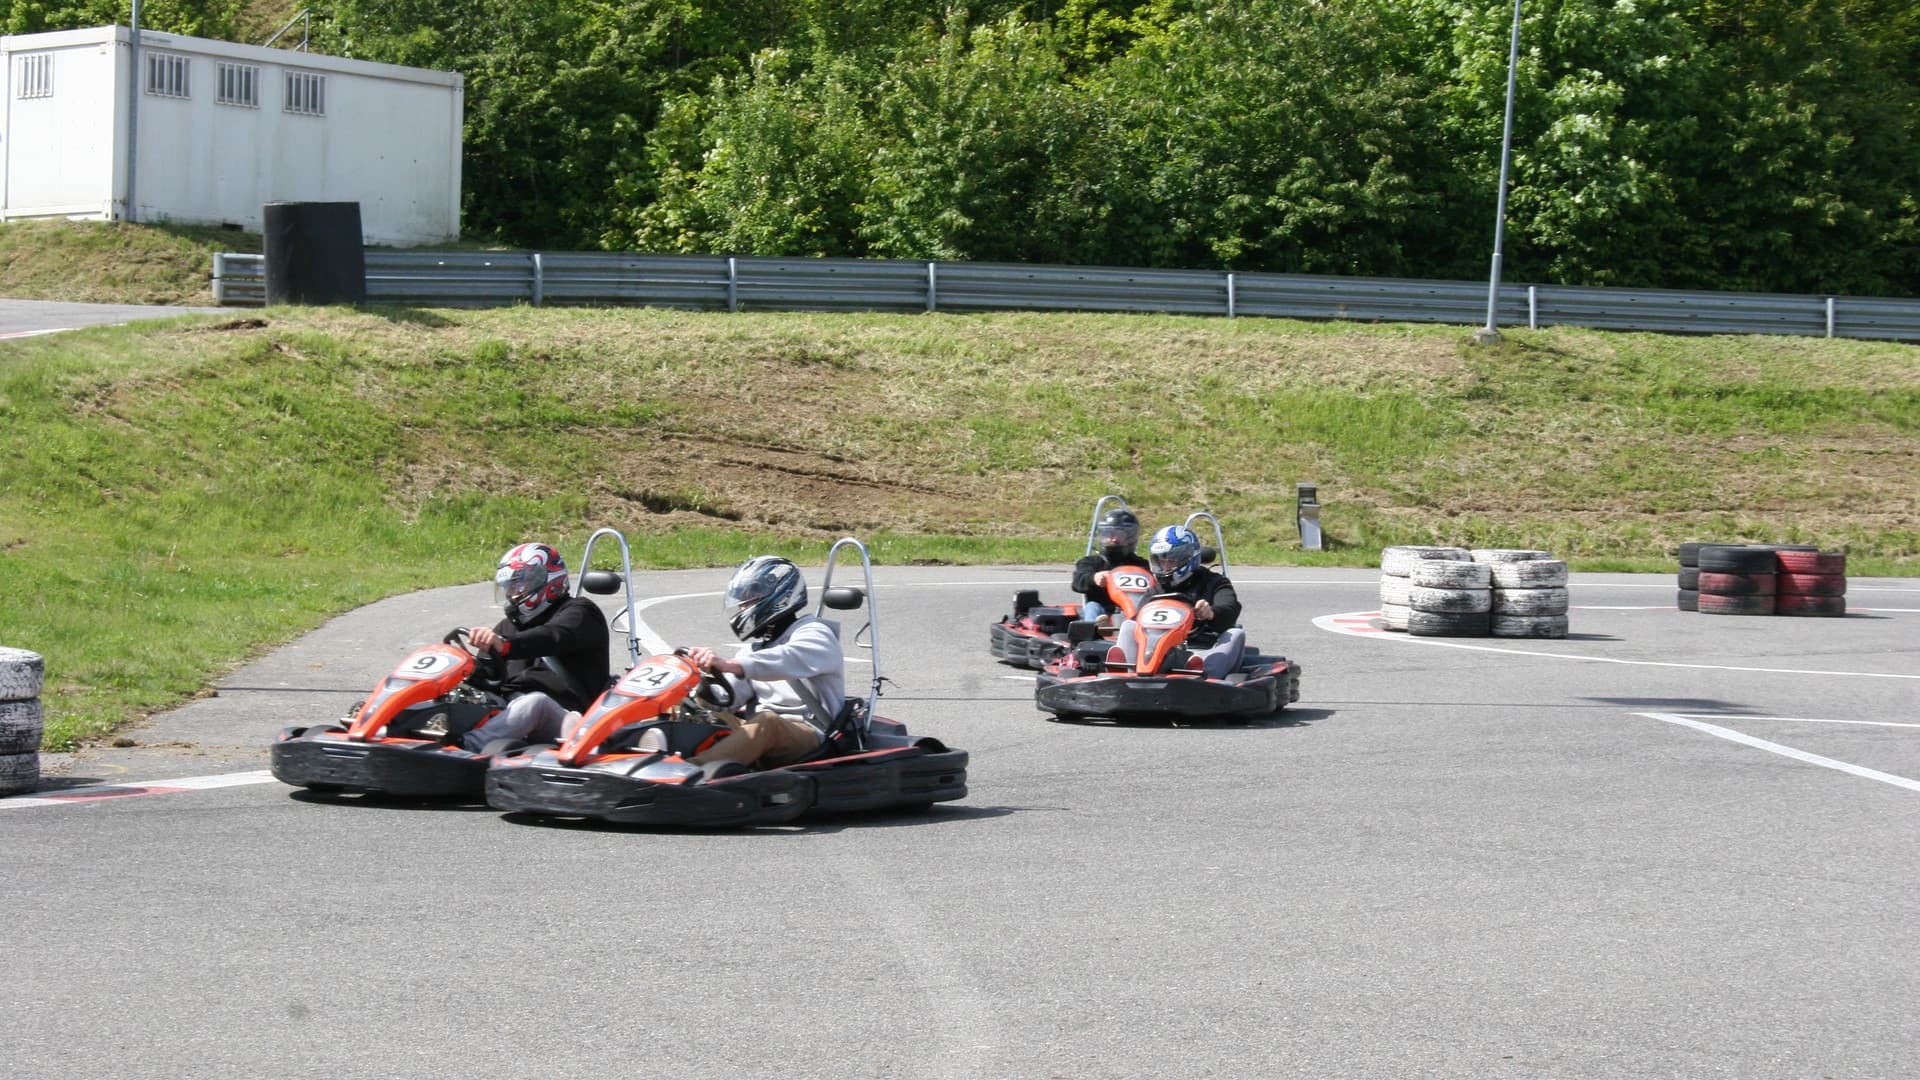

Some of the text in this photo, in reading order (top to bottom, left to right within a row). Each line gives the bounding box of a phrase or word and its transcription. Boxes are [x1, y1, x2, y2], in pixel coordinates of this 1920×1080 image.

[1119, 576, 1148, 588] 20
[1152, 610, 1169, 622] 5
[412, 656, 437, 670] 9
[628, 667, 671, 686] 24
